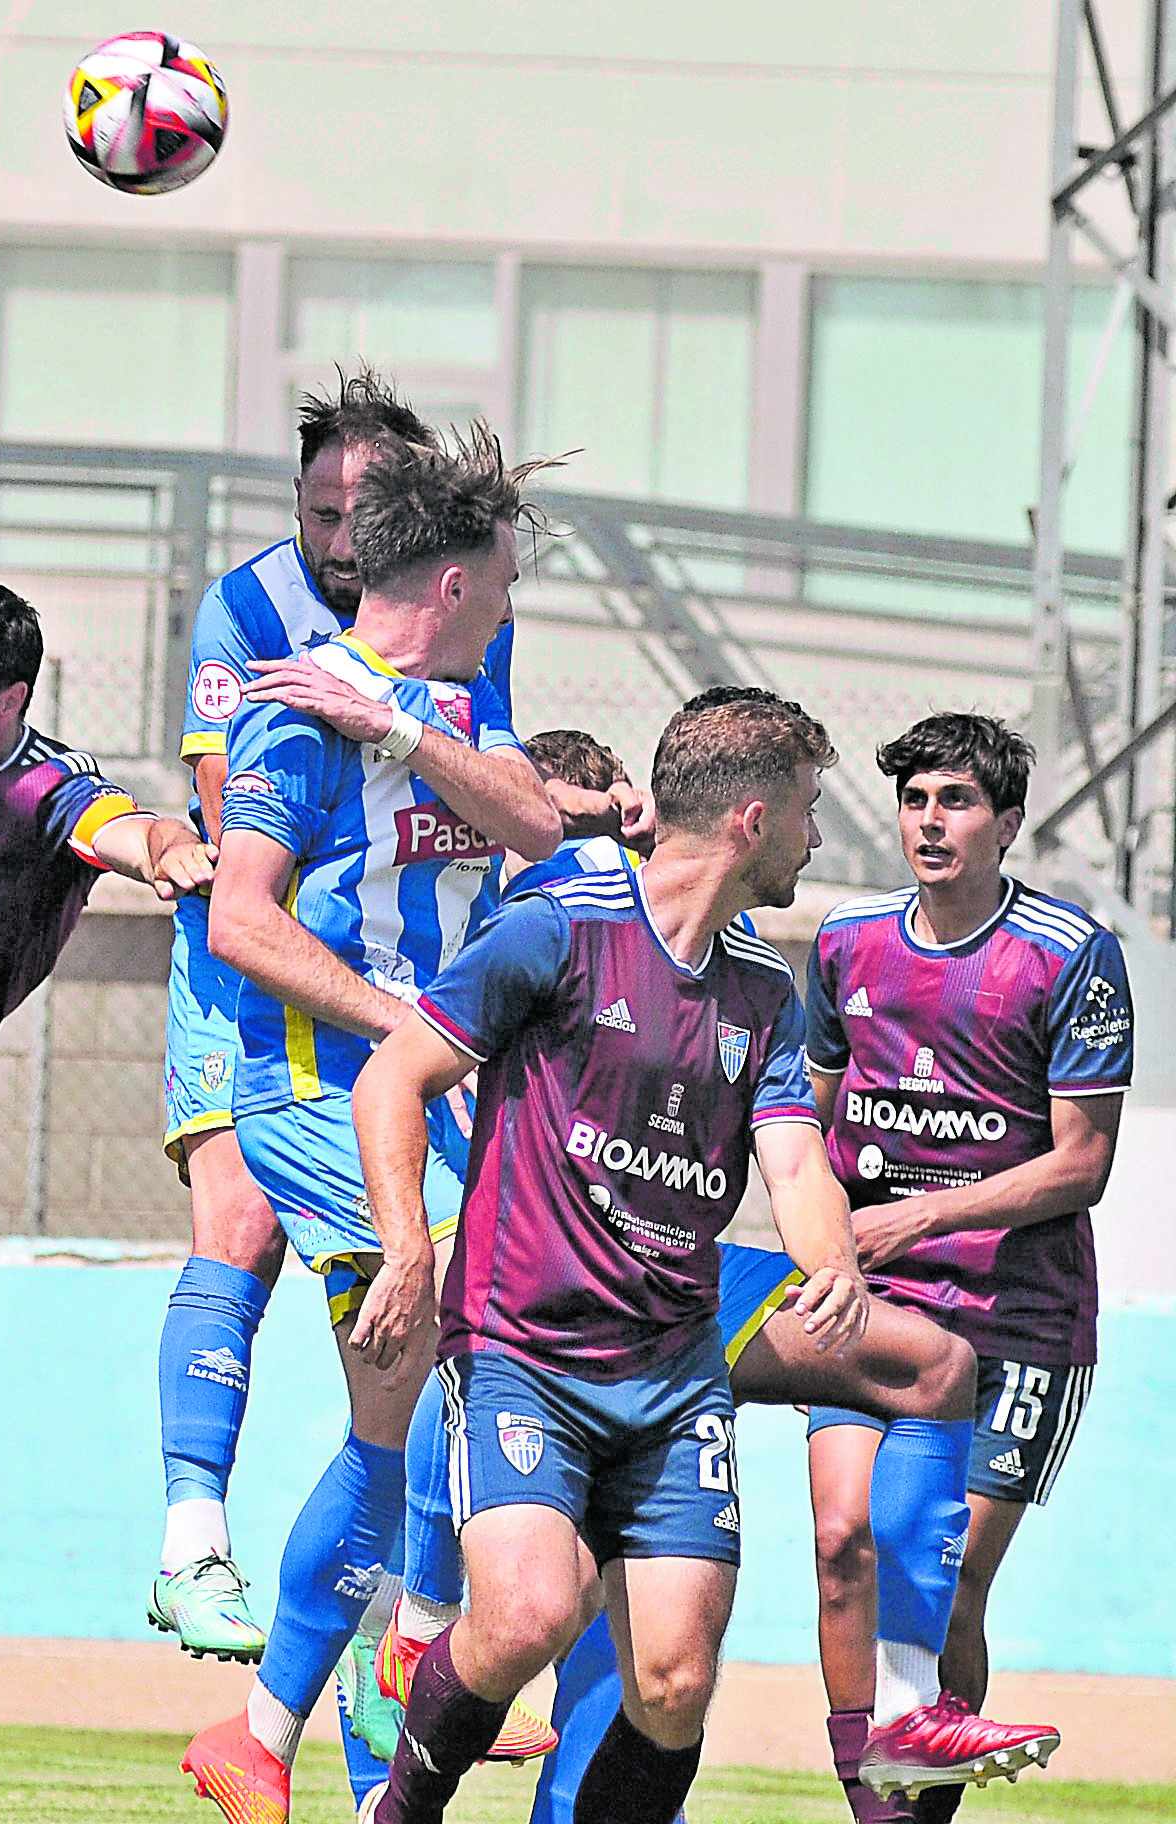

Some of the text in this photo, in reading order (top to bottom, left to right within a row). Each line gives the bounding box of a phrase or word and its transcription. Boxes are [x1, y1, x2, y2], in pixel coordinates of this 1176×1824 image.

[595, 1014, 636, 1034] adidas
[898, 1076, 945, 1094] SEGOVIA
[846, 1091, 1008, 1141] BIOAMMO
[565, 1121, 727, 1200] BIOAMMO
[990, 1359, 1052, 1441] 15
